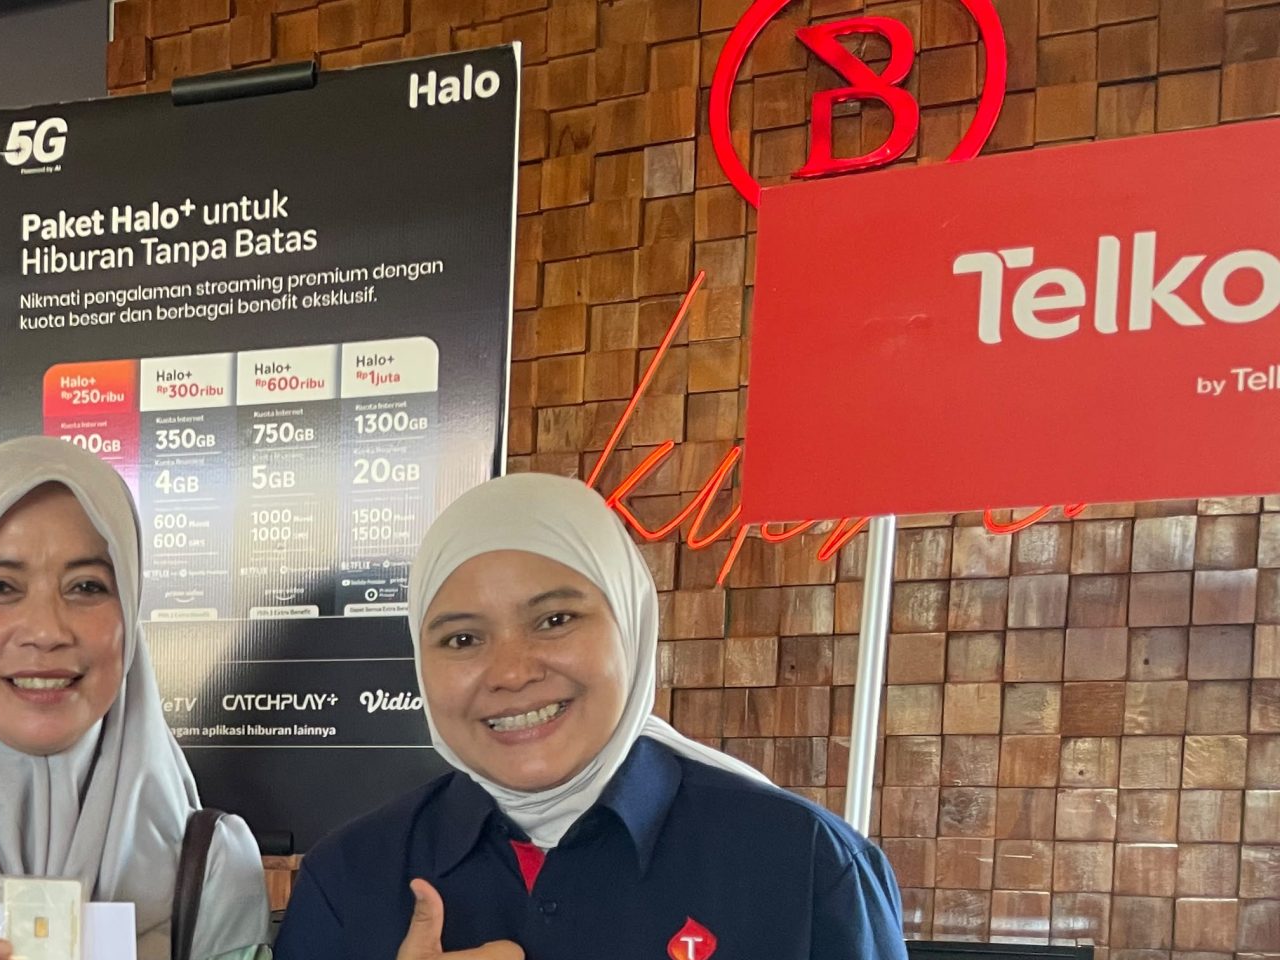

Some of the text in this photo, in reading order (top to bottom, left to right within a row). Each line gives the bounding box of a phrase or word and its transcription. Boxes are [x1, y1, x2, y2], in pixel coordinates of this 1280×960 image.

[408, 64, 500, 108] Halo
[1, 117, 68, 166] 5G
[22, 189, 289, 241] Paket Halo+ untuk
[22, 228, 318, 275] Hiburan Tanpa Batas
[20, 260, 444, 309] Nikmati pengalaman streaming premium dengan
[952, 231, 1280, 344] Telko
[20, 314, 65, 330] kuota
[69, 311, 116, 326] besar
[119, 307, 152, 324] dan
[156, 299, 234, 322] berbagai
[237, 293, 298, 315] benefit
[254, 362, 292, 375] Halo+
[356, 354, 395, 368] Halo+
[60, 375, 96, 388] Halo+
[156, 369, 193, 382] Halo+
[1196, 376, 1227, 396] by
[253, 422, 314, 445] 750GB
[354, 411, 428, 434] 1300GB
[155, 427, 216, 450] 350GB
[154, 470, 200, 494] 4GB
[252, 464, 295, 489] 5GB
[352, 457, 421, 485] 20GB
[153, 513, 187, 529] 600
[250, 509, 291, 524] 1000
[352, 508, 392, 524] 1500
[153, 532, 187, 548] 600
[250, 526, 291, 541] 1000
[352, 526, 392, 541] 1500
[222, 693, 339, 711] CATCHPLAY+
[359, 689, 424, 714] Vidio
[202, 724, 245, 738] aplikasi
[247, 724, 291, 736] hiburan
[293, 724, 337, 738] lainnya
